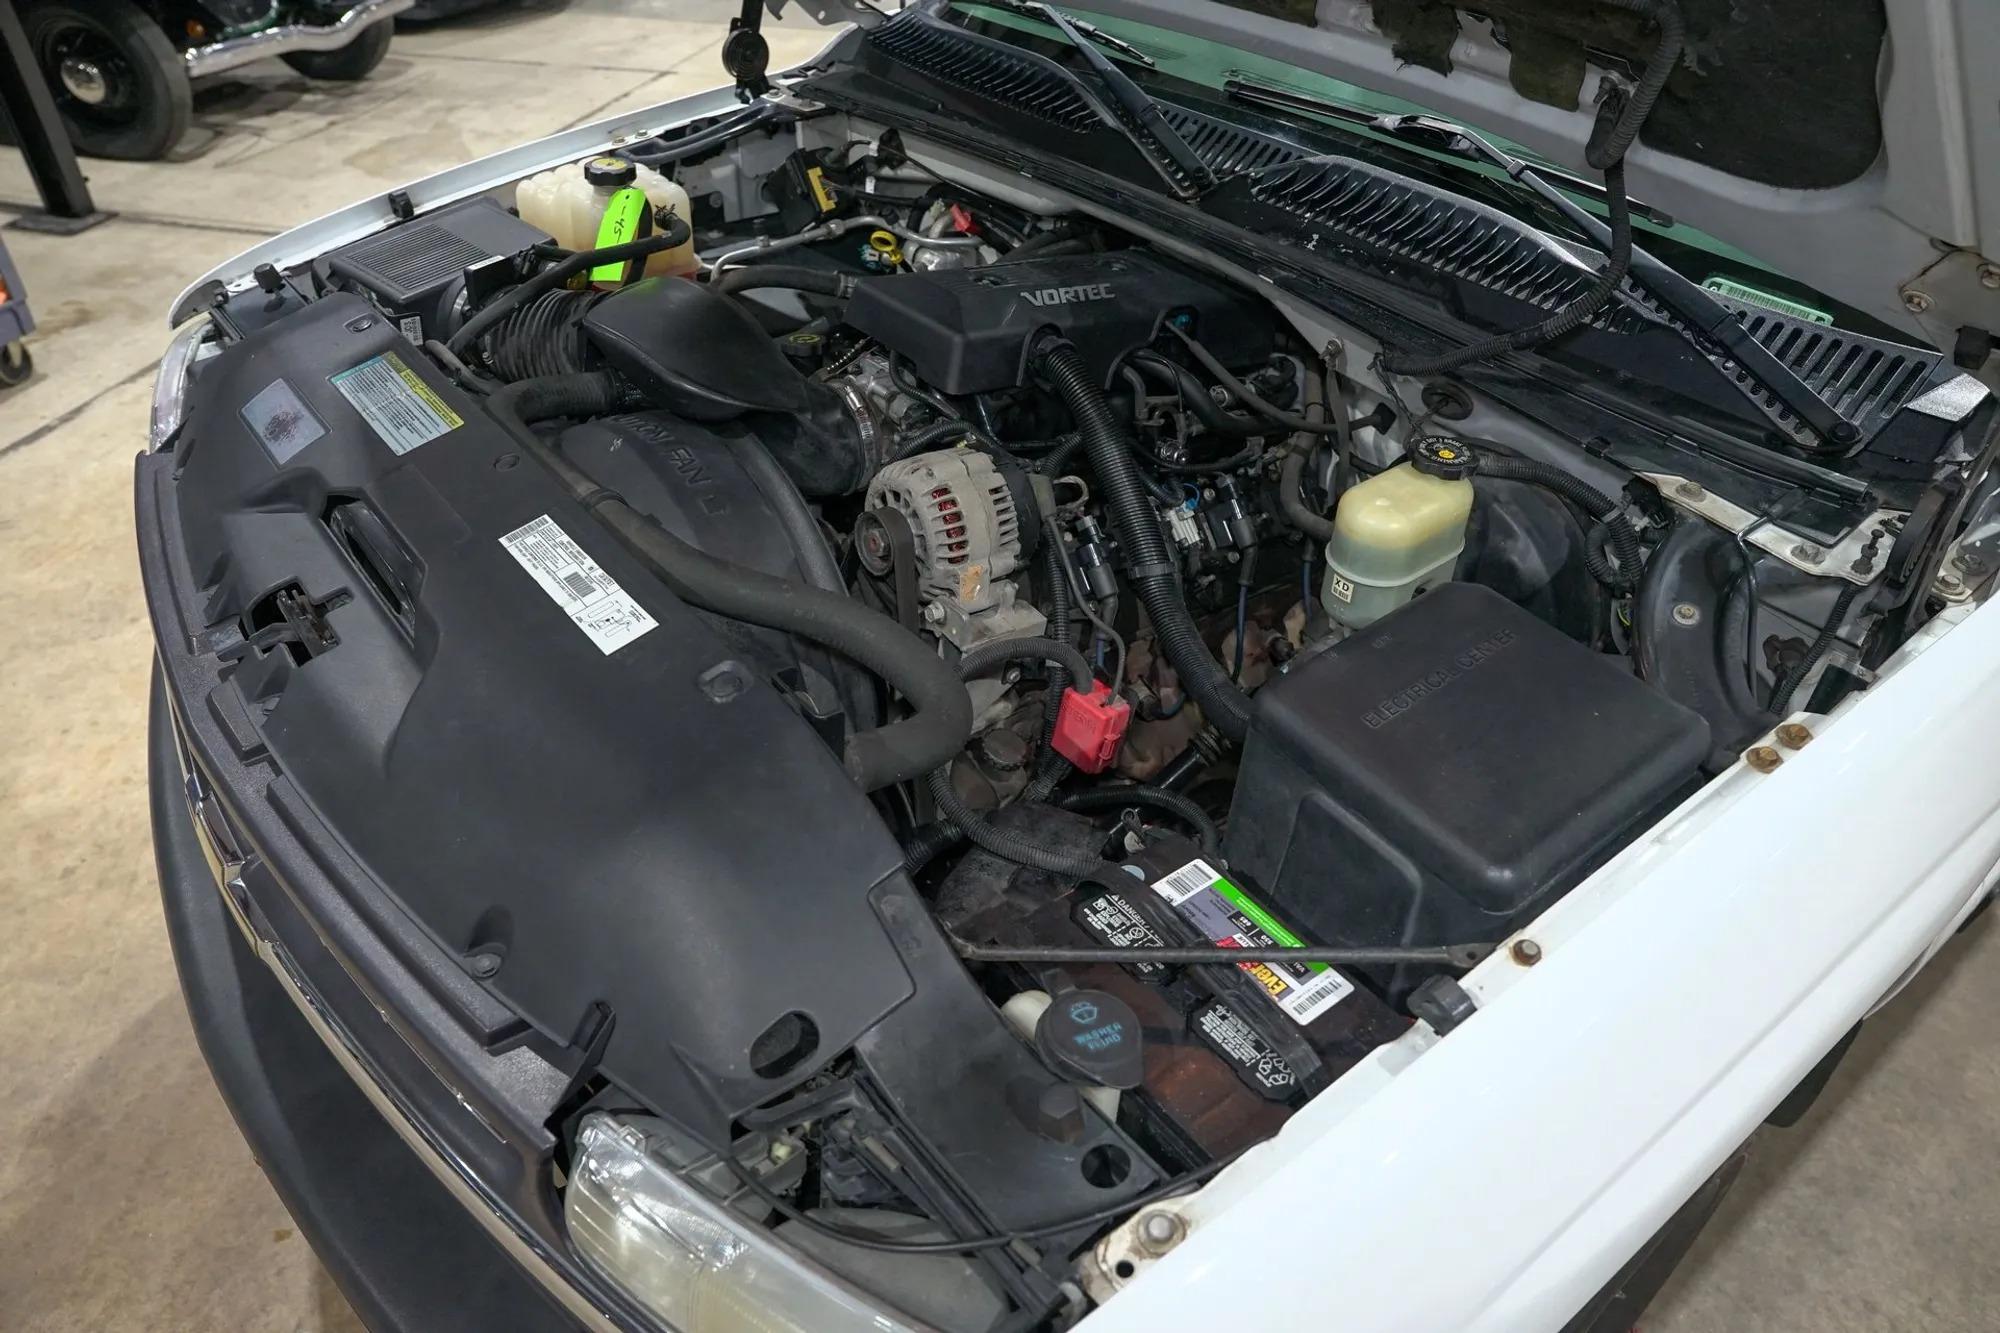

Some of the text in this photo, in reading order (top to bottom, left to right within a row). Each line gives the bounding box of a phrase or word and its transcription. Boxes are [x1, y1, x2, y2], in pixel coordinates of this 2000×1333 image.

[1020, 283, 1116, 307] VORTEC
[1360, 627, 1519, 729] ELECTRICAL CENTER
